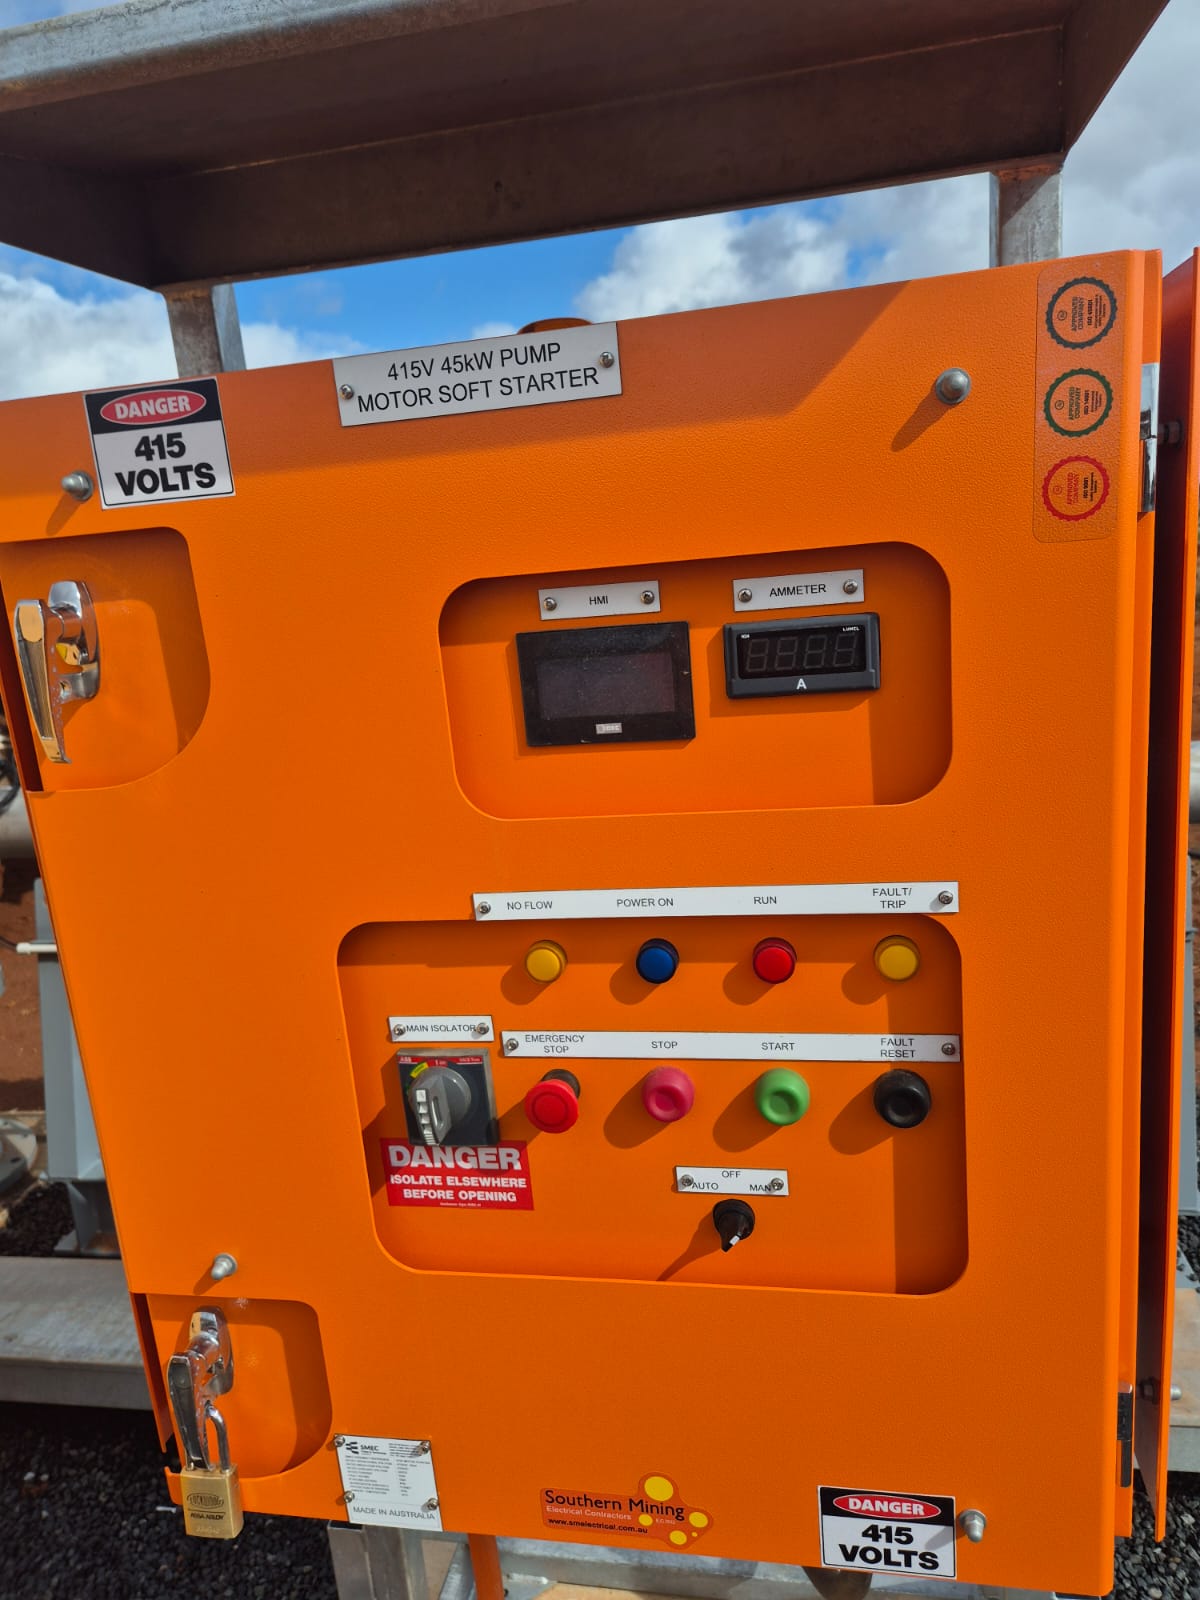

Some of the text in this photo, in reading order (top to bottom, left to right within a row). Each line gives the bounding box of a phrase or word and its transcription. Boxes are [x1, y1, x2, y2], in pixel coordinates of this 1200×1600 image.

[387, 341, 562, 381] 415V 45kW PUMP
[358, 366, 599, 413] MOTOR SOFT STARTER
[114, 395, 192, 420] DANGER
[134, 431, 186, 461] 415
[114, 462, 217, 496] VOLTS
[769, 583, 827, 598] AMMETER
[589, 594, 609, 606] HMI
[796, 678, 808, 690] A
[872, 887, 912, 897] FAULT/
[506, 900, 553, 910] NO FLOW
[616, 897, 674, 908] POWER ON
[753, 896, 777, 905] RUN
[880, 899, 906, 909] TRIP
[406, 1024, 476, 1033] MAIN ISOLATOR
[525, 1034, 585, 1043] EMERGENCY
[651, 1040, 678, 1049] STOP
[880, 1037, 915, 1047] FAULT
[543, 1045, 569, 1054] STOP
[761, 1042, 795, 1051] START
[880, 1049, 916, 1058] RESET
[388, 1145, 522, 1171] DANGER
[721, 1170, 741, 1178] OFF
[390, 1174, 527, 1189] ISOLATE ELSEWHERE
[692, 1182, 719, 1190] AUTO
[749, 1184, 771, 1192] MAN
[403, 1188, 517, 1202] BEFORE OPENING
[545, 1489, 685, 1521] Southern Mining
[848, 1498, 925, 1516] DANGER
[353, 1506, 377, 1515] MADE
[389, 1510, 435, 1520] AUSTRALIA
[546, 1505, 632, 1520] Electrical Contractors
[548, 1518, 648, 1534] www.smelectrical.com.au
[861, 1524, 914, 1545] 415
[838, 1544, 940, 1570] VOLTS
